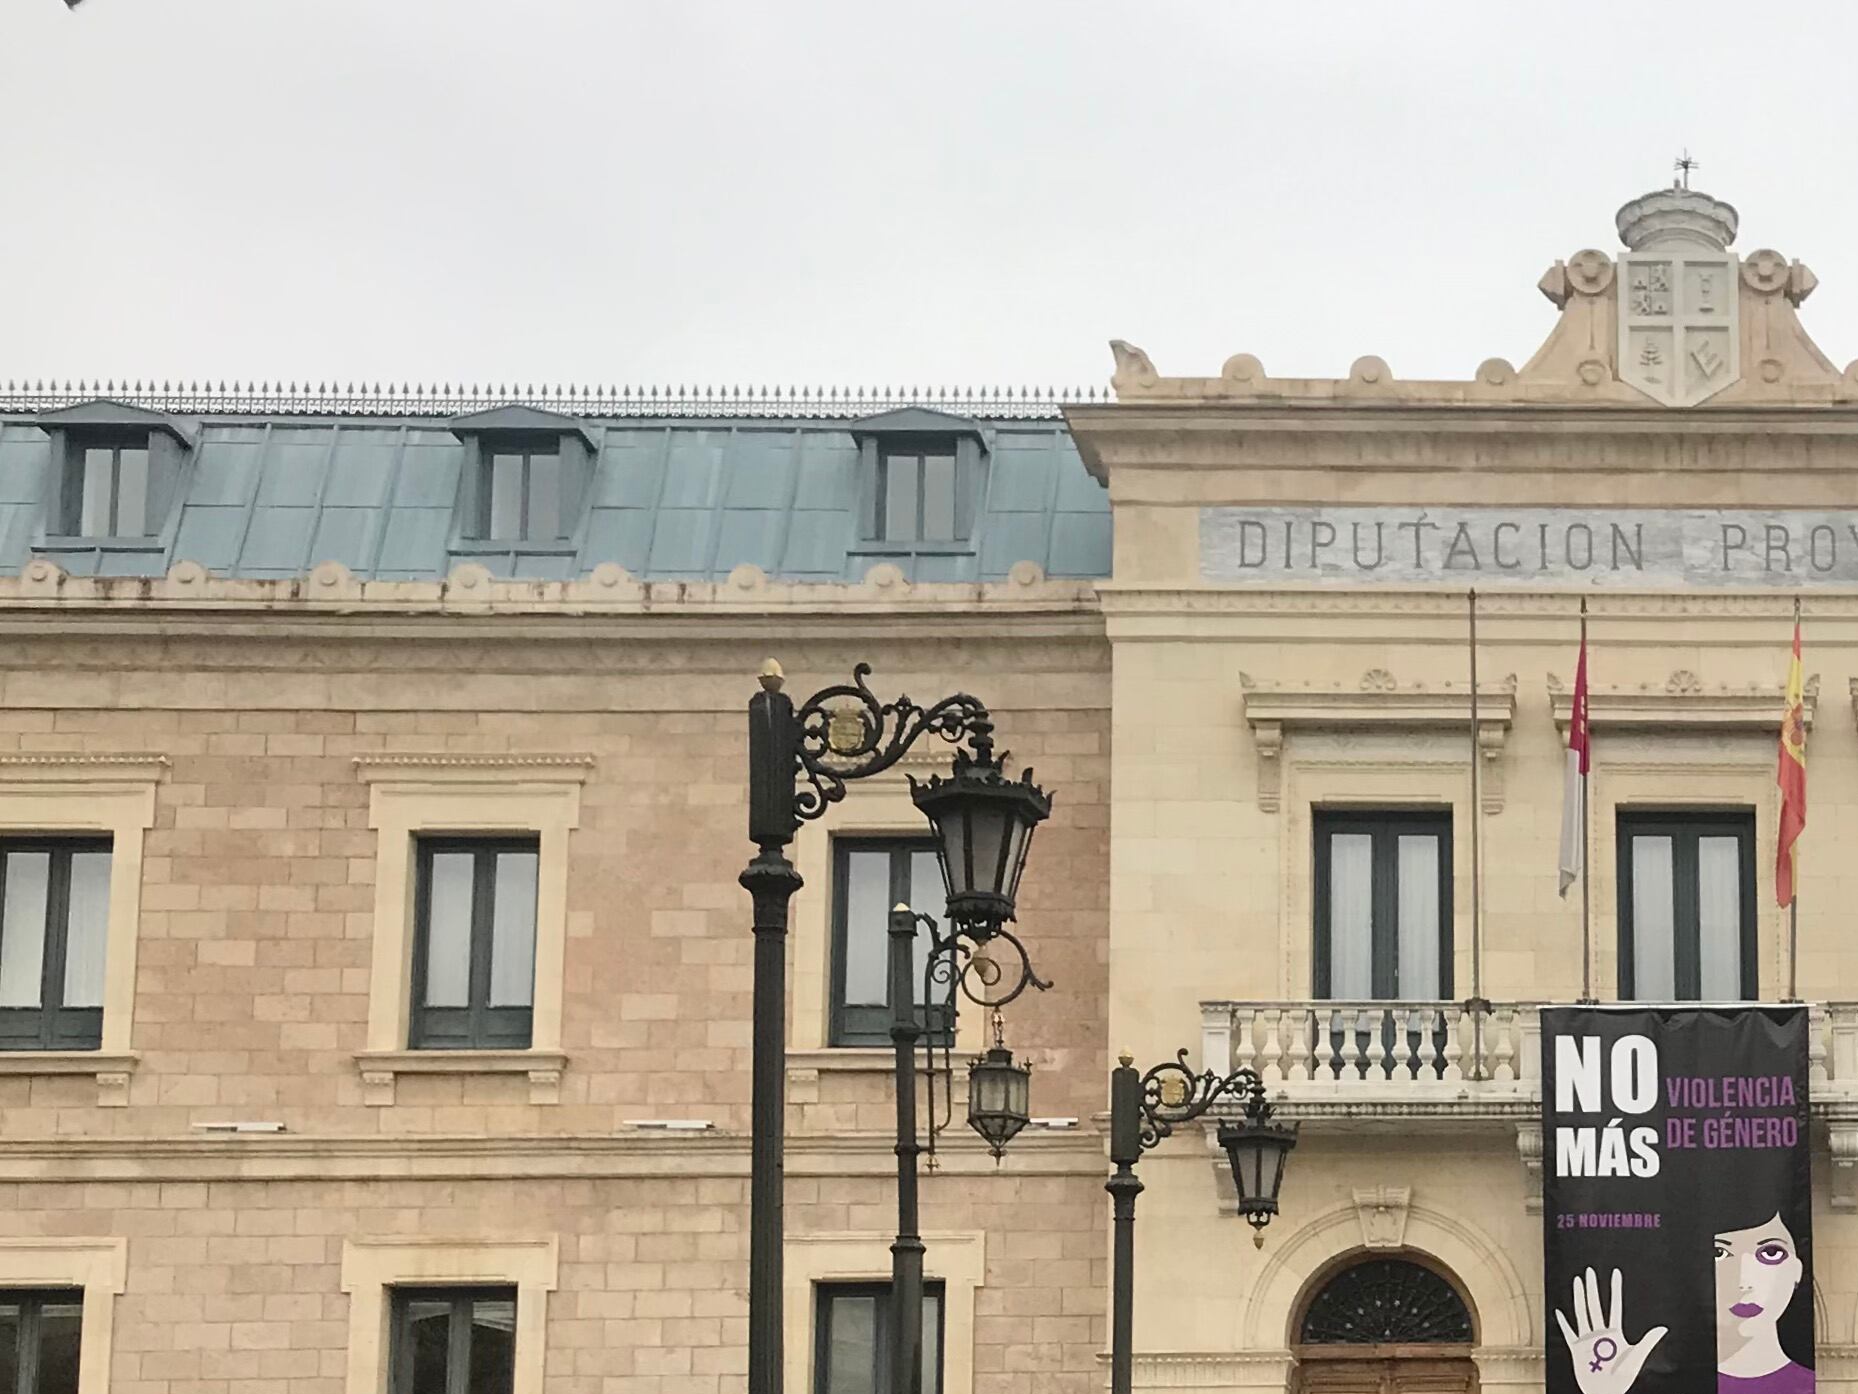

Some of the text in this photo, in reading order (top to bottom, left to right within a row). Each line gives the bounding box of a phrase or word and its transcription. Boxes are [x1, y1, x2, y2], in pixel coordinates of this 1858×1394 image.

[1238, 519, 1644, 572] DIPUTACION
[1555, 1035, 1658, 1114] NO
[1666, 1076, 1796, 1108] VIOLENCIA
[1556, 1118, 1660, 1178] MÁS
[1666, 1111, 1798, 1149] DE GÉNERO
[1557, 1212, 1661, 1229] 25 NOVIEMBRE
